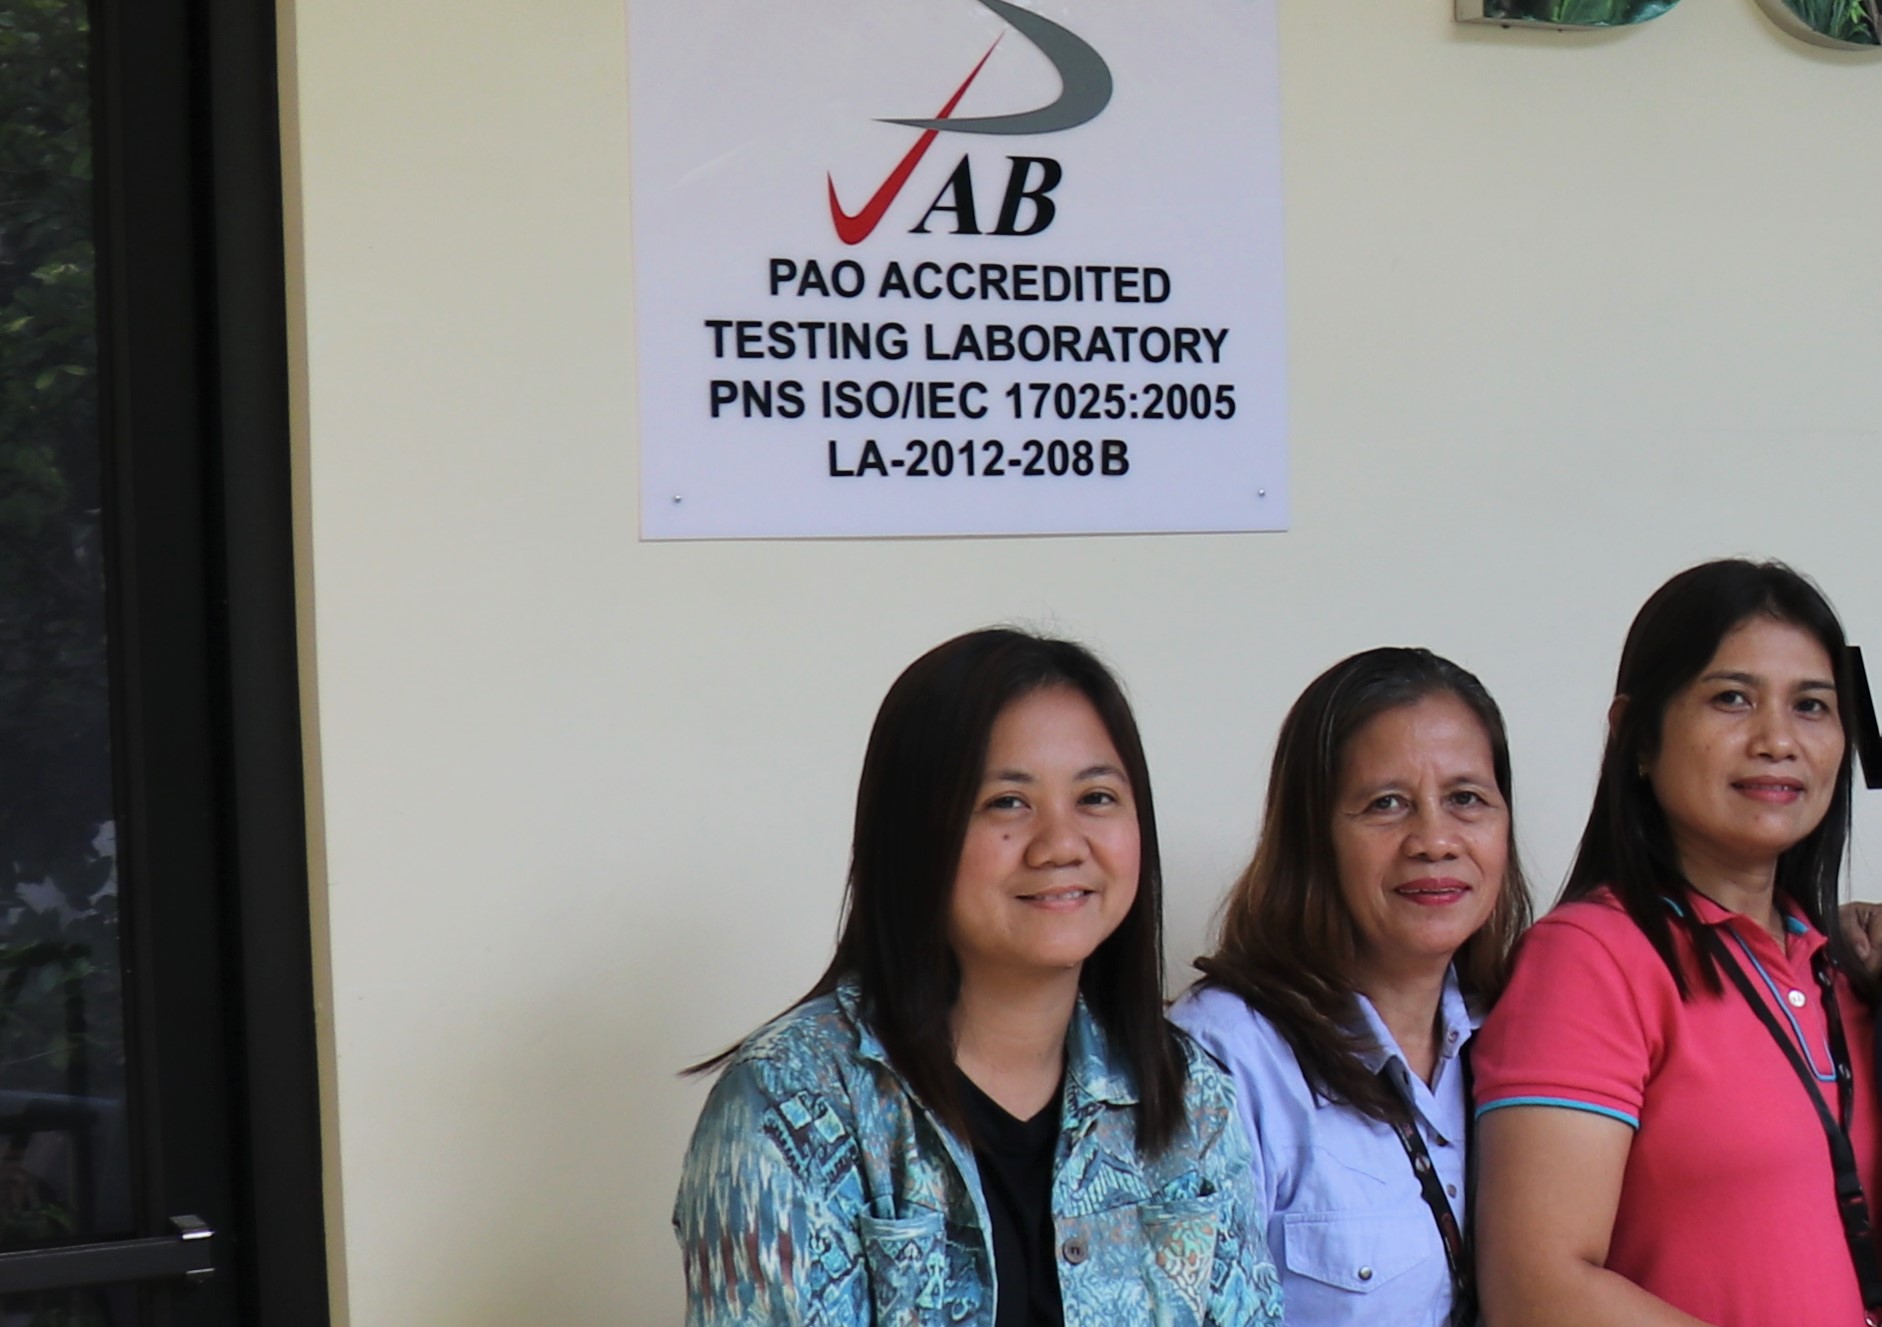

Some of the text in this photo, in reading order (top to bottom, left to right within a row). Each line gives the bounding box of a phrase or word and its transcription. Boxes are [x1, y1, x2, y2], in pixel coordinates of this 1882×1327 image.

[769, 259, 1171, 303] PAO ACCREDITED
[705, 320, 1229, 363] TESTING LABORATORY
[709, 381, 1236, 420] PNS ISO/IEC 17025:2005
[827, 440, 1130, 477] LA-2012-208B
